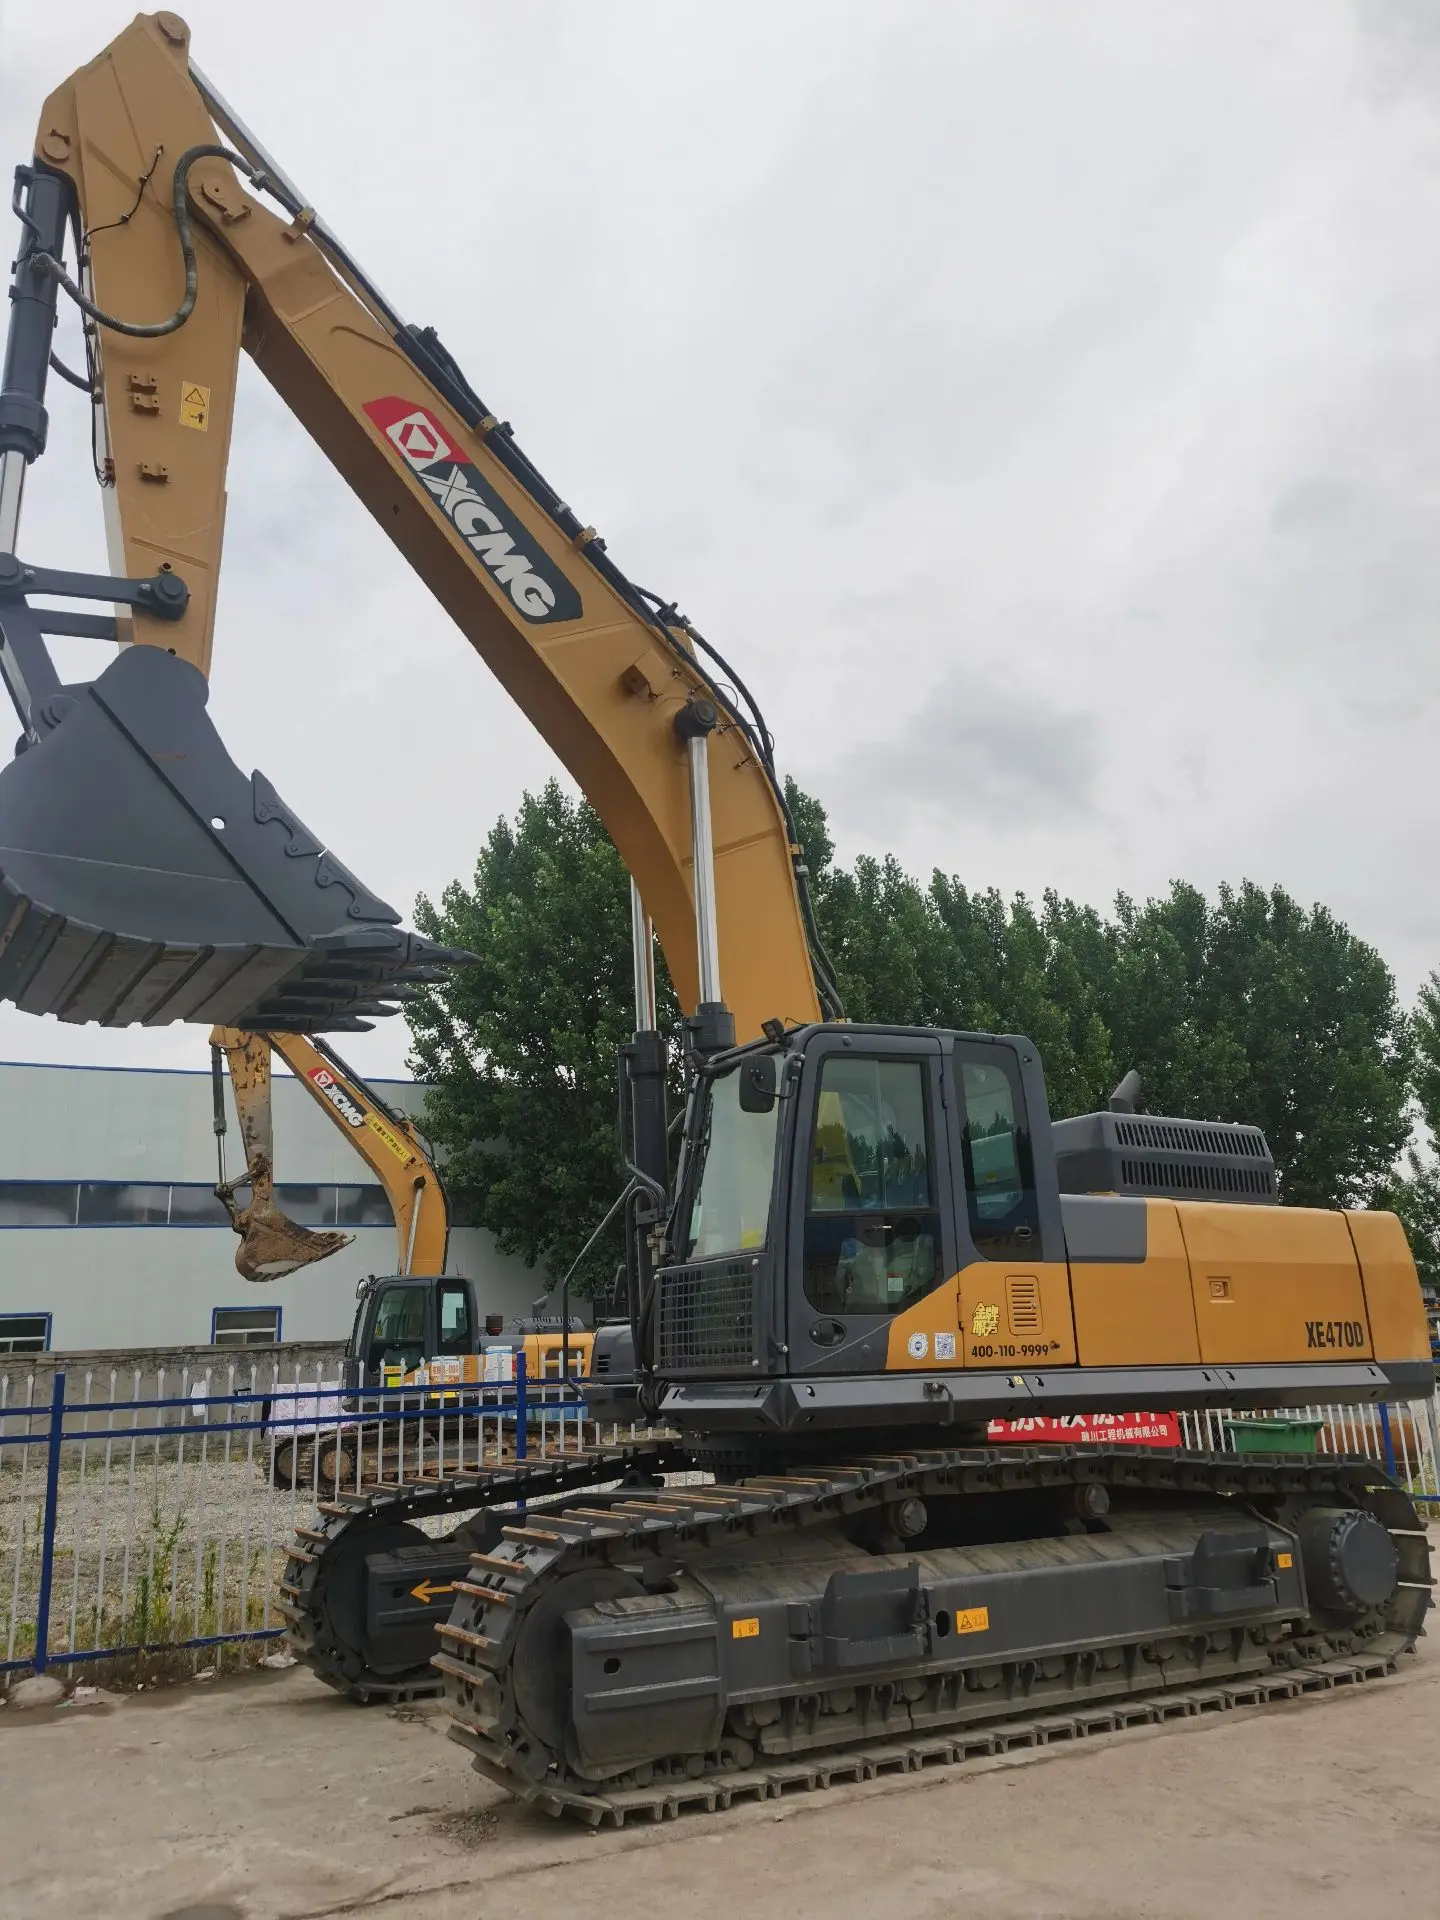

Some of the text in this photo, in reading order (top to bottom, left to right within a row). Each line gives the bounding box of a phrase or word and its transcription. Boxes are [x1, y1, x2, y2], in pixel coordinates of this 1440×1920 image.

[418, 464, 556, 617] XCMG
[324, 1084, 363, 1126] XCMG
[972, 1302, 1000, 1323] 金牌
[1304, 1321, 1364, 1348] XE470D
[971, 1344, 1049, 1358] 400-110-9999
